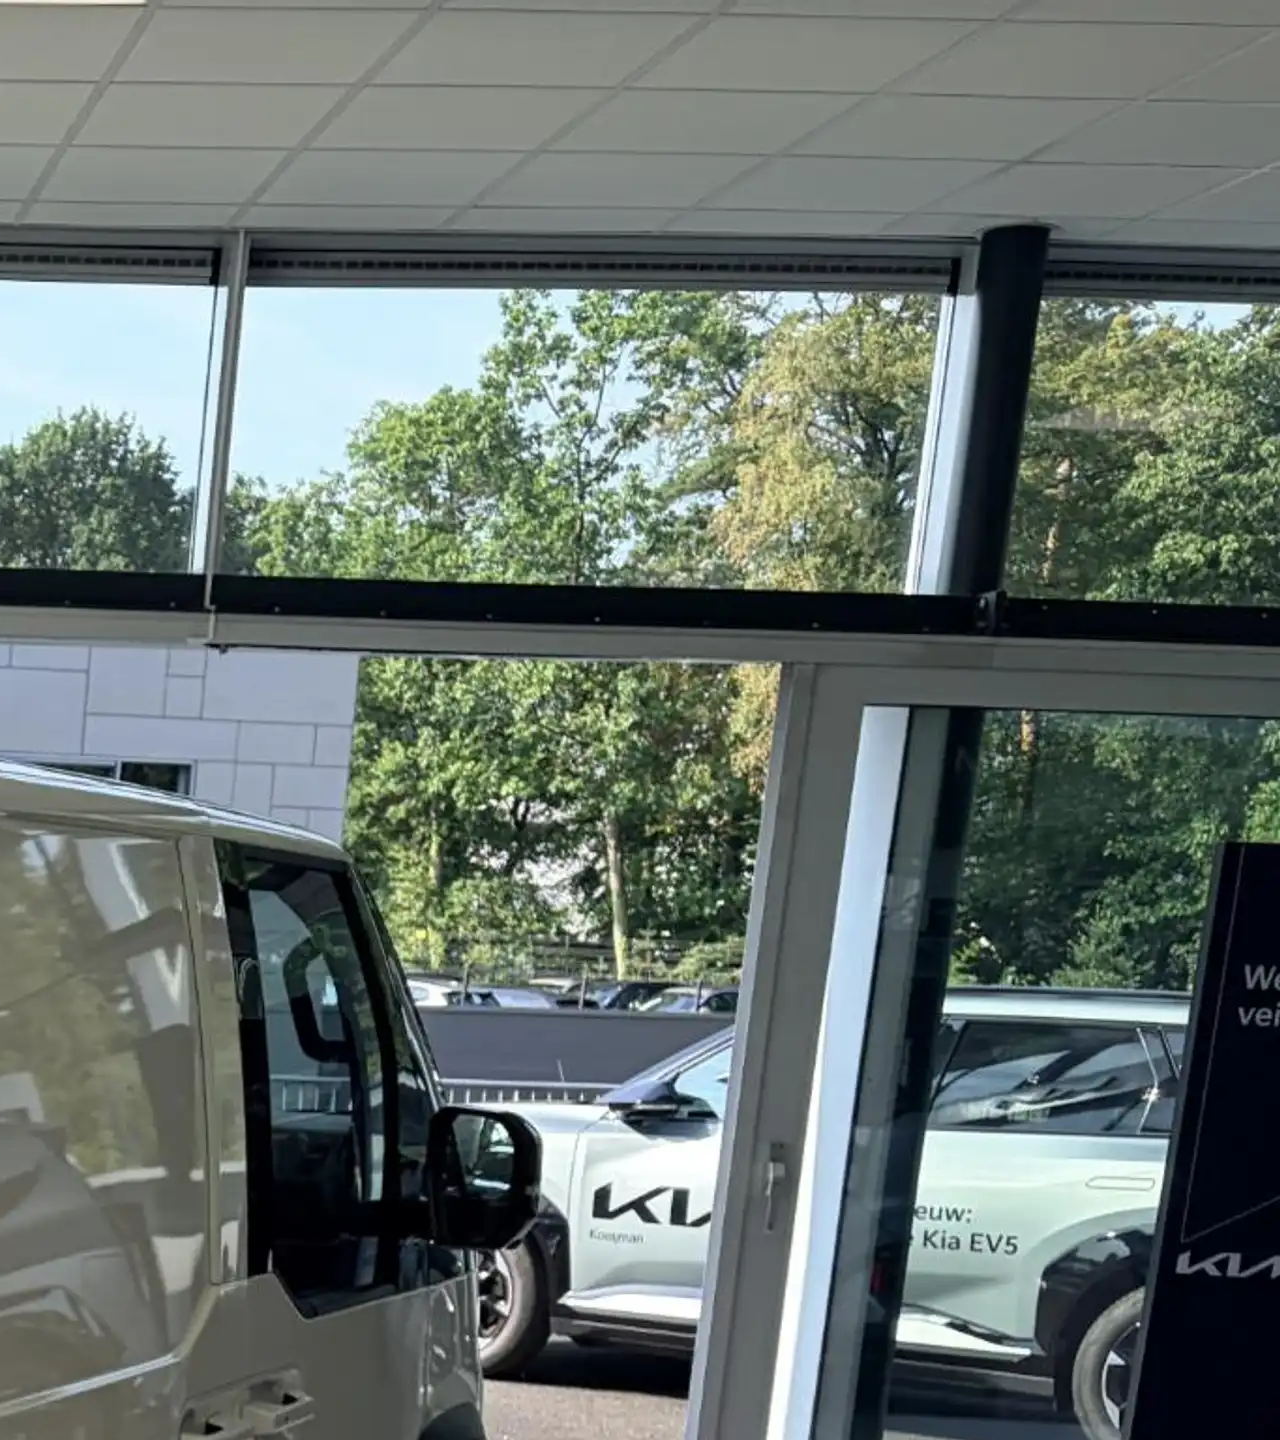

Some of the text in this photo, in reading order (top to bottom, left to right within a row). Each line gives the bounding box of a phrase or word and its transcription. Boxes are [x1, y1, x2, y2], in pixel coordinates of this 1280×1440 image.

[913, 1205, 973, 1224] euw:
[923, 1229, 961, 1251] Kia
[970, 1232, 1018, 1256] EV5
